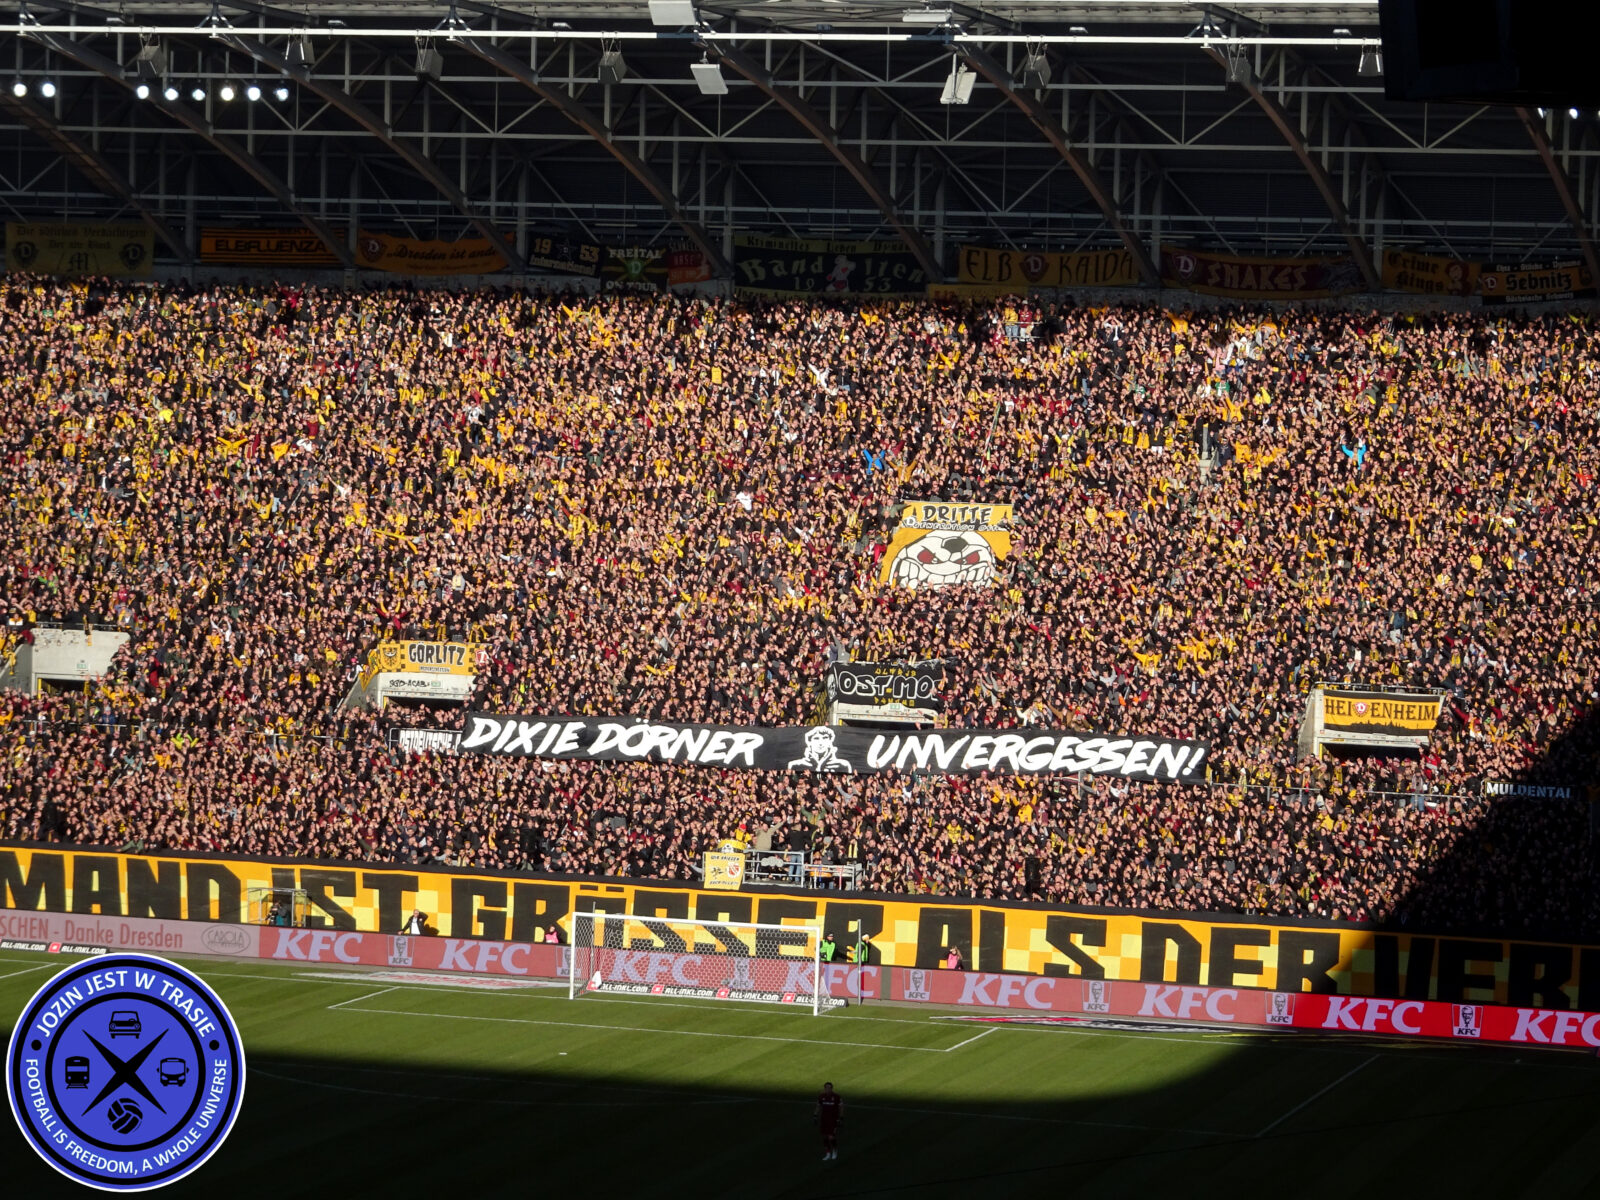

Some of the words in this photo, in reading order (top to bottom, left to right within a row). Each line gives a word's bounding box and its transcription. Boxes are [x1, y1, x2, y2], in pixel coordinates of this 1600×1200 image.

[534, 238, 552, 255] 19
[579, 244, 600, 264] 53
[609, 247, 662, 259] FREITAL
[965, 249, 1012, 282] ELB
[1058, 250, 1133, 285] KAIDA
[1207, 262, 1309, 291] SNAKES
[1505, 271, 1573, 291] Sebnitz
[922, 504, 992, 524] DRITTE
[408, 641, 466, 667] GÖRLITZ
[461, 716, 588, 755] DIXIE
[587, 717, 764, 767] DÖRNER
[866, 733, 1206, 779] UNVERGESSEN!
[64, 919, 114, 944] Danke
[119, 923, 184, 949] Dresden
[271, 867, 419, 935] IST
[450, 877, 885, 966] GRÖSSER
[915, 907, 1108, 980] ALS
[1140, 921, 1341, 994] DER
[272, 928, 364, 963] KFC
[438, 938, 532, 974] KFC
[391, 957, 411, 965] KFC
[608, 949, 703, 986] KFC
[908, 991, 927, 999] KFC
[957, 973, 1057, 1009] KFC
[1137, 984, 1239, 1021] KFC
[1086, 1003, 1107, 1011] KFC
[1270, 1014, 1290, 1024] KFC
[1321, 996, 1425, 1034] KFC
[1457, 1027, 1478, 1036] KFC
[1510, 1008, 1600, 1047] KFC
